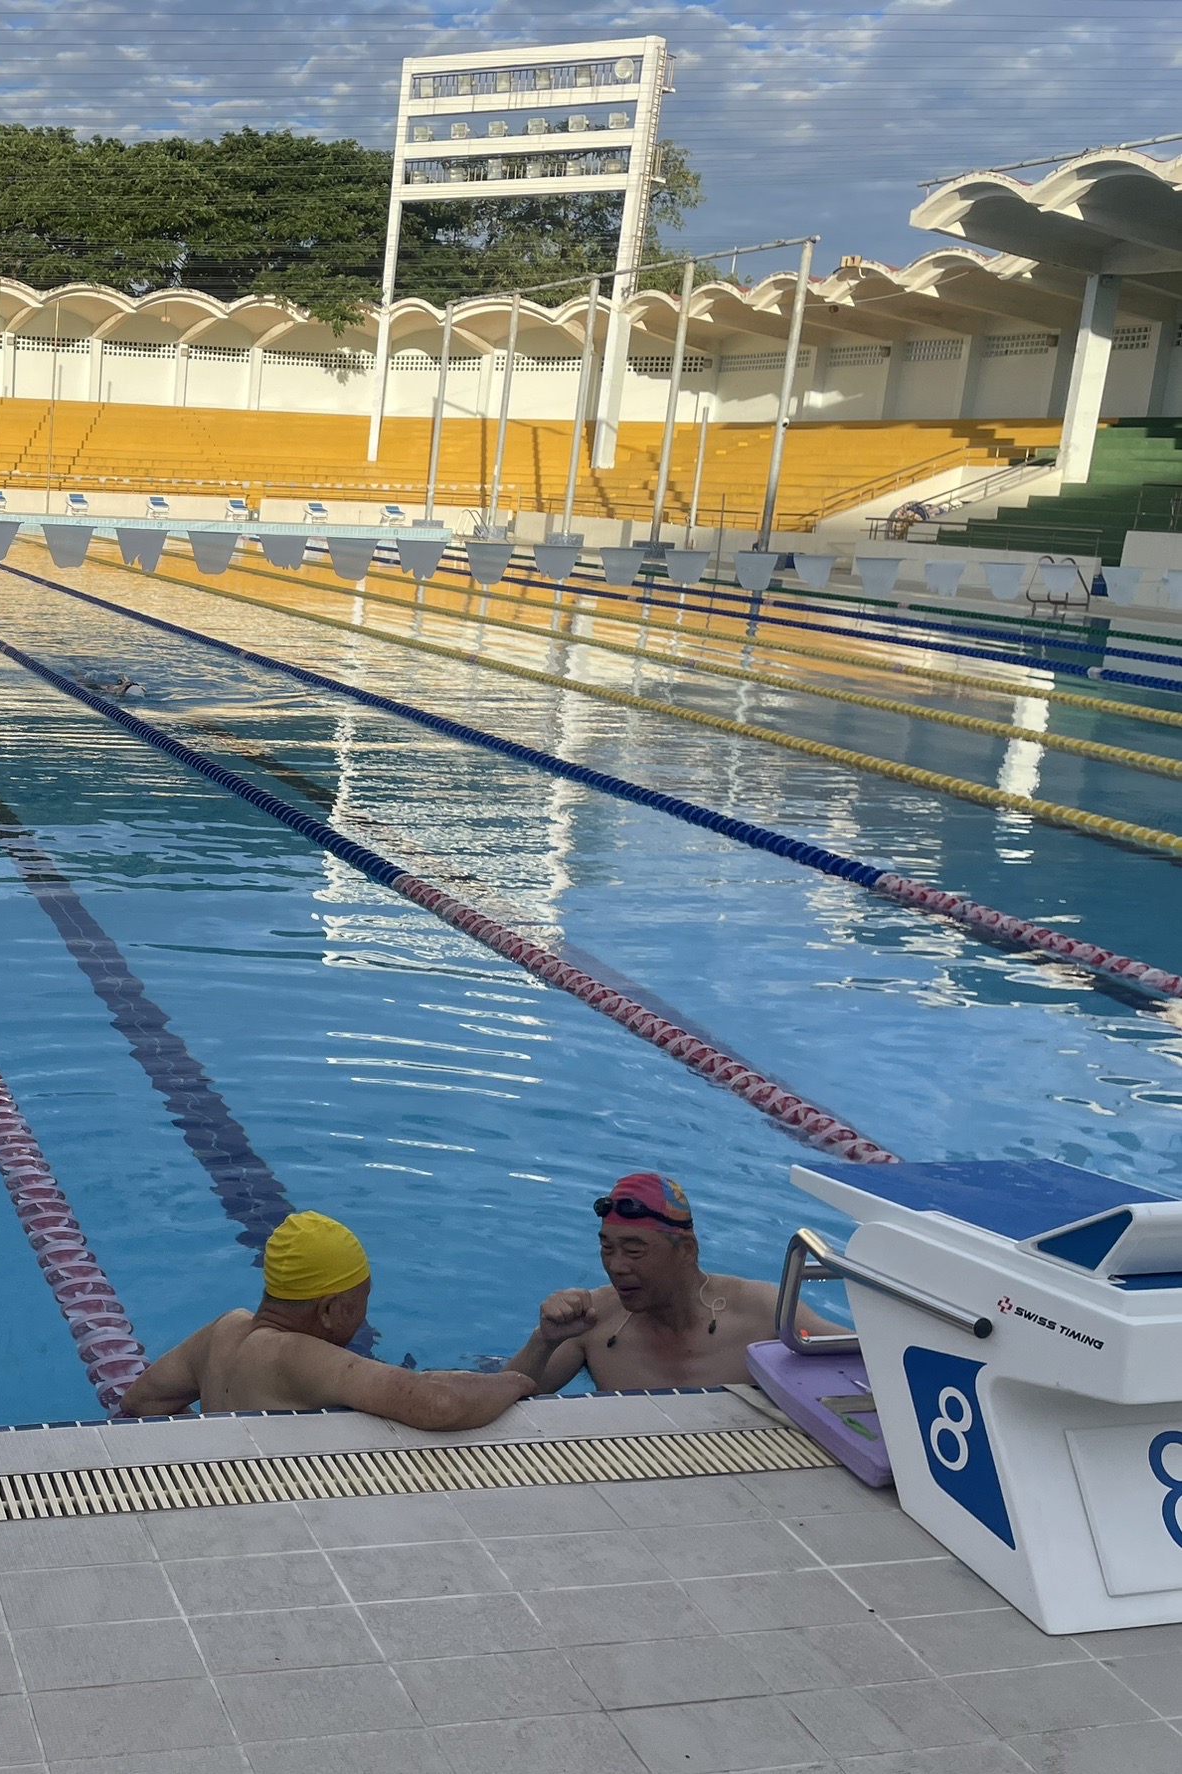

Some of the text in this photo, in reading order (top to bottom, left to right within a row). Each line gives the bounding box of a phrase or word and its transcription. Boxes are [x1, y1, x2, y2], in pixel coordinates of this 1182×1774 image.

[1014, 1306, 1104, 1350] SWISS TIMING
[930, 1386, 973, 1471] 8
